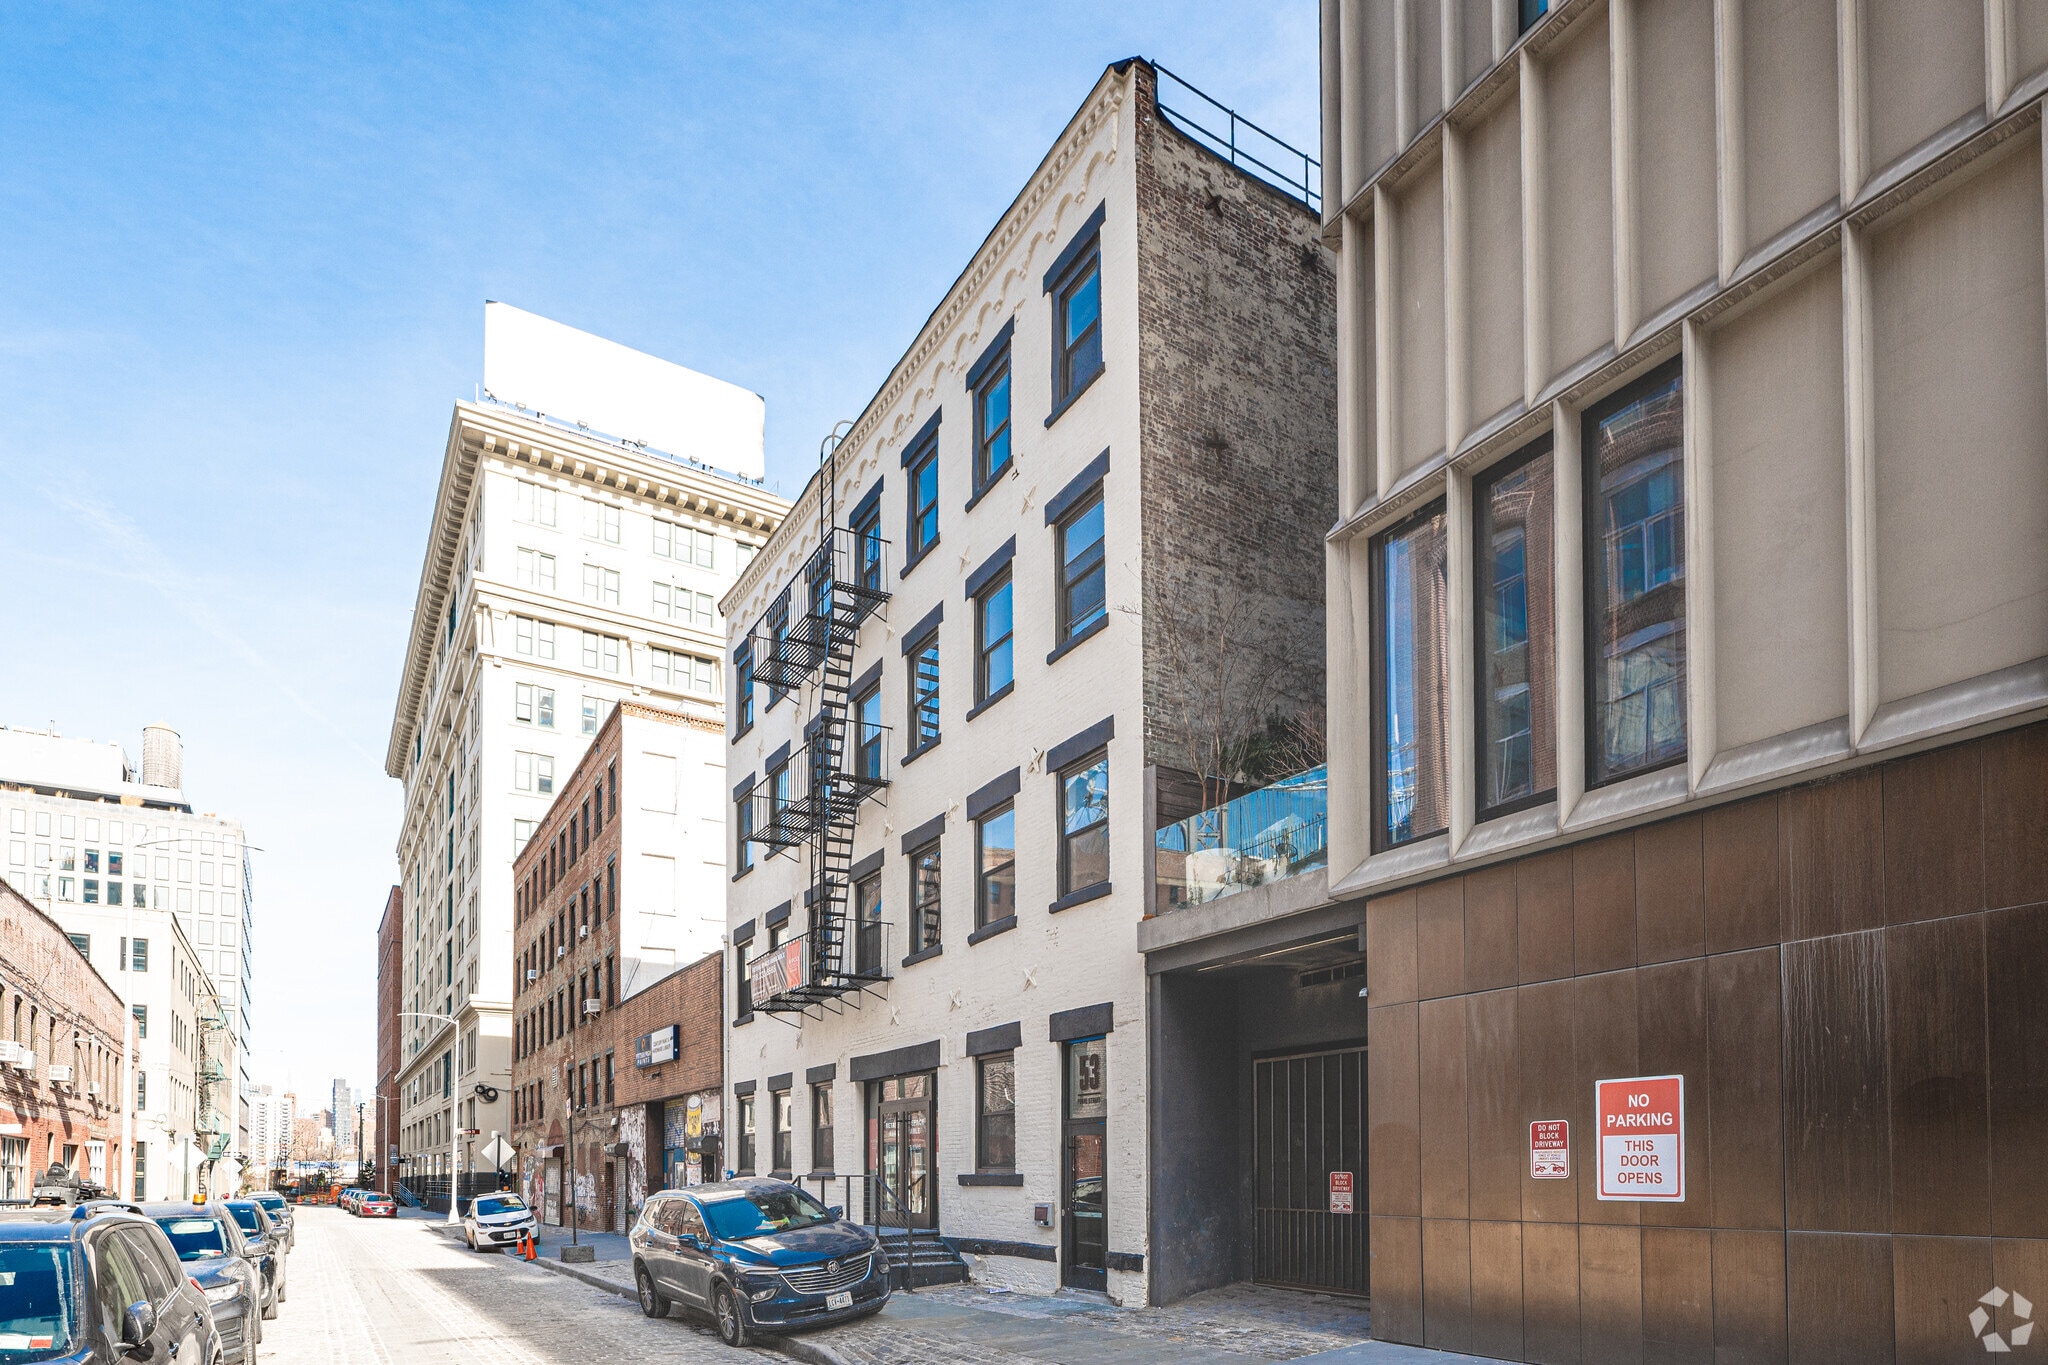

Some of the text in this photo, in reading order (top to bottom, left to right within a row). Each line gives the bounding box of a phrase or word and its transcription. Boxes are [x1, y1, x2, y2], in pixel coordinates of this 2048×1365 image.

[1080, 1054, 1100, 1090] 53
[1628, 1093, 1650, 1107] NO
[1606, 1112, 1673, 1128] PARKING
[1548, 1123, 1561, 1131] NOT
[1539, 1132, 1560, 1140] BLOCK
[1534, 1140, 1564, 1148] DRIVEWAY
[1624, 1139, 1654, 1152] THIS
[1620, 1154, 1660, 1167] DOOR
[1617, 1172, 1663, 1184] OPENS
